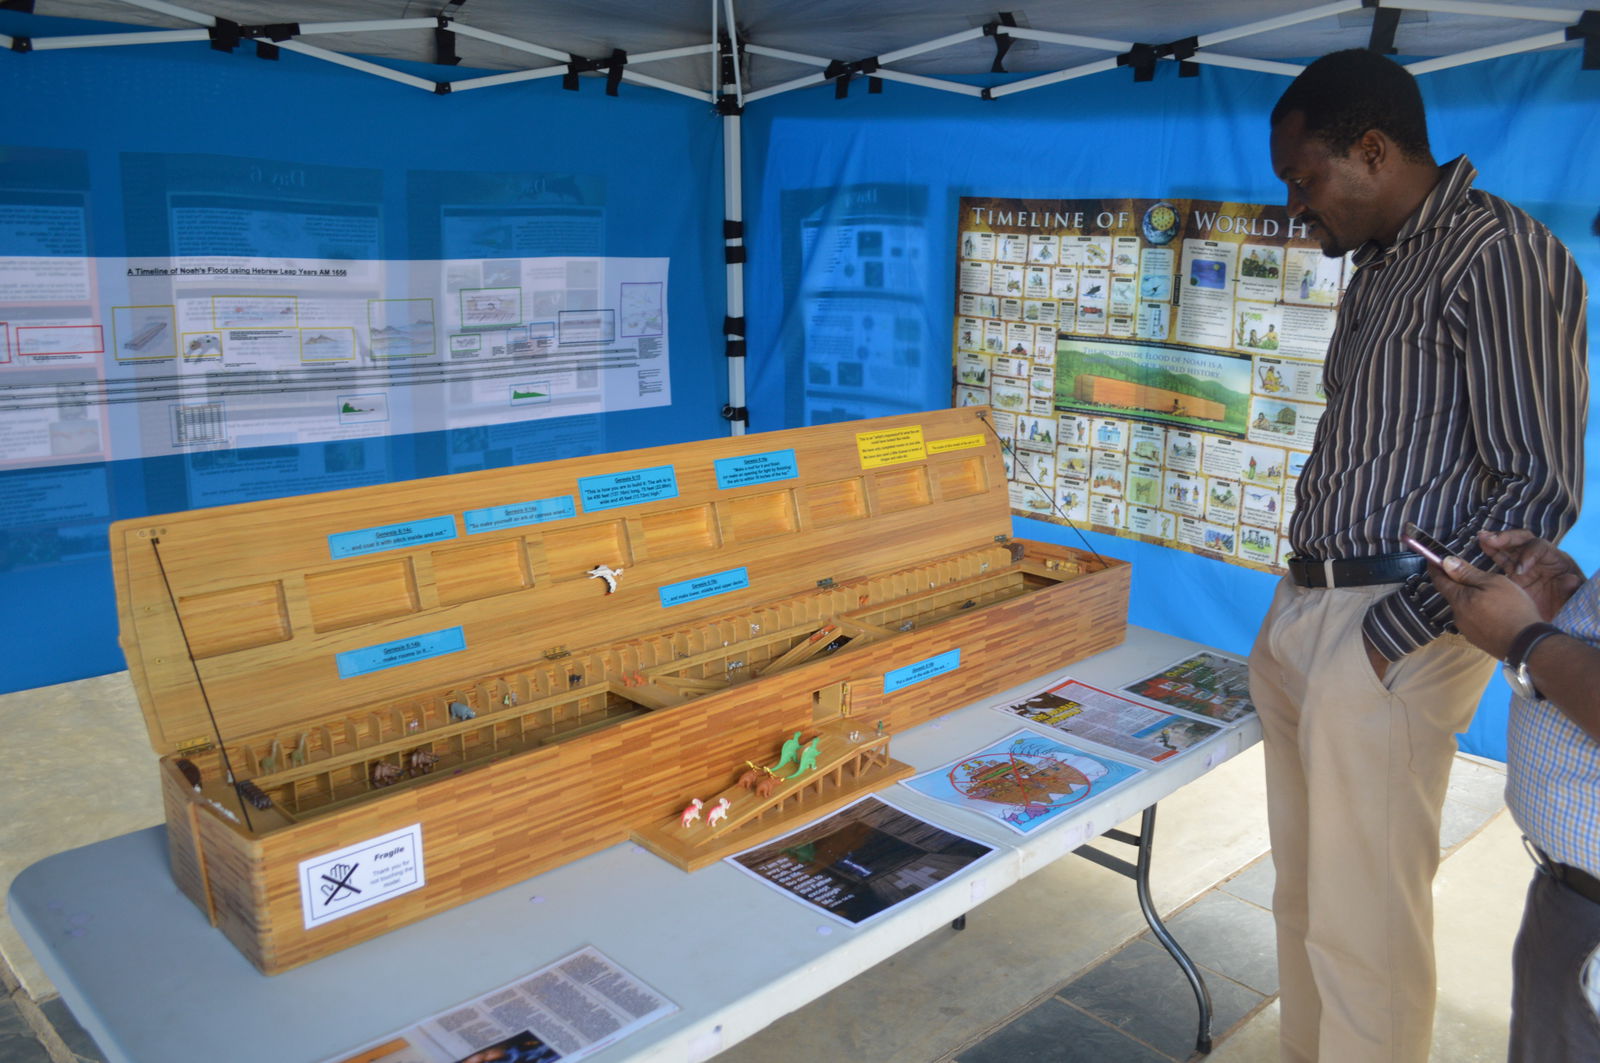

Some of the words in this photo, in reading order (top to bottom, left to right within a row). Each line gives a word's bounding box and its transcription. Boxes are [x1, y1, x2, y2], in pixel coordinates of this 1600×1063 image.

[972, 207, 1084, 228] TIMELINE
[1097, 212, 1129, 228] OF
[1194, 210, 1279, 237] WORLD
[1287, 218, 1307, 238] H
[128, 268, 134, 276] A
[136, 268, 168, 276] Timeline
[207, 266, 228, 275] Flood
[1145, 352, 1170, 361] FLOOD
[1182, 356, 1206, 367] NOAH
[375, 530, 397, 539] Genesis
[383, 645, 406, 655] Genesis
[374, 846, 405, 861] Fragile
[372, 867, 390, 876] Thank
